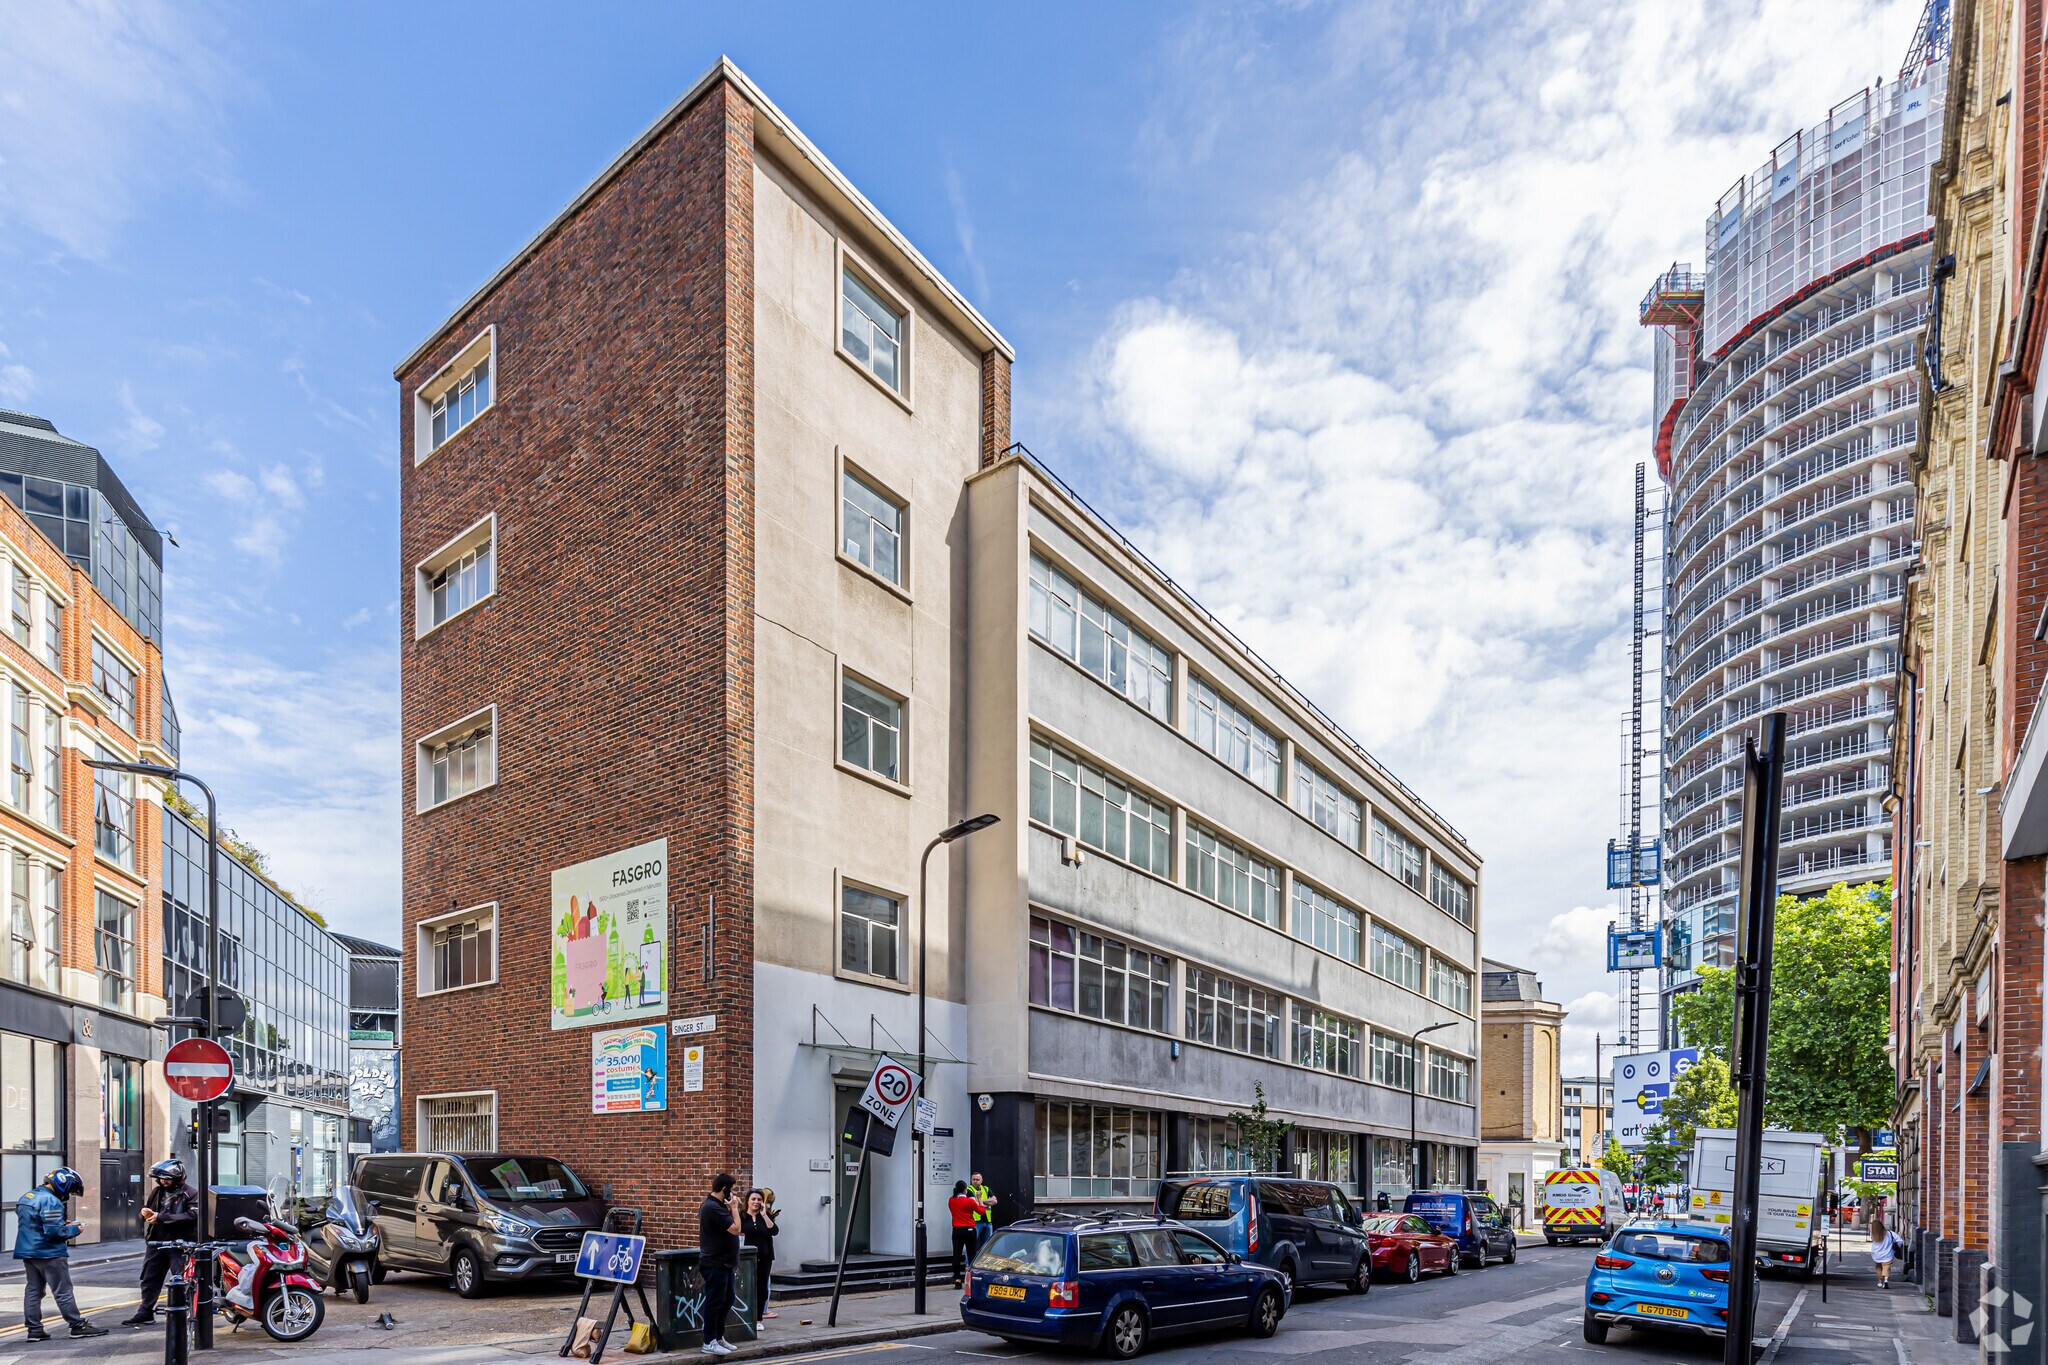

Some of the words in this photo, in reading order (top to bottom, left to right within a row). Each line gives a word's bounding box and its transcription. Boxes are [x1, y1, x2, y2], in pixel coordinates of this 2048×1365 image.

[1906, 100, 1922, 112] JRL
[1778, 174, 1791, 187] JRL
[612, 860, 662, 887] FASGRO
[82, 1017, 93, 1038] &
[674, 1023, 694, 1034] SINGER
[626, 1032, 645, 1041] COSTUME
[594, 1055, 606, 1066] Over
[606, 1065, 641, 1074] costumes
[360, 1082, 386, 1098] BEE
[881, 1073, 906, 1097] 20
[6, 1085, 29, 1110] DE
[866, 1095, 896, 1122] ZONE
[1867, 1166, 1895, 1175] STAR
[560, 1254, 576, 1262] BL19
[1640, 1304, 1665, 1315] LG70
[1666, 1307, 1685, 1318] DSU
